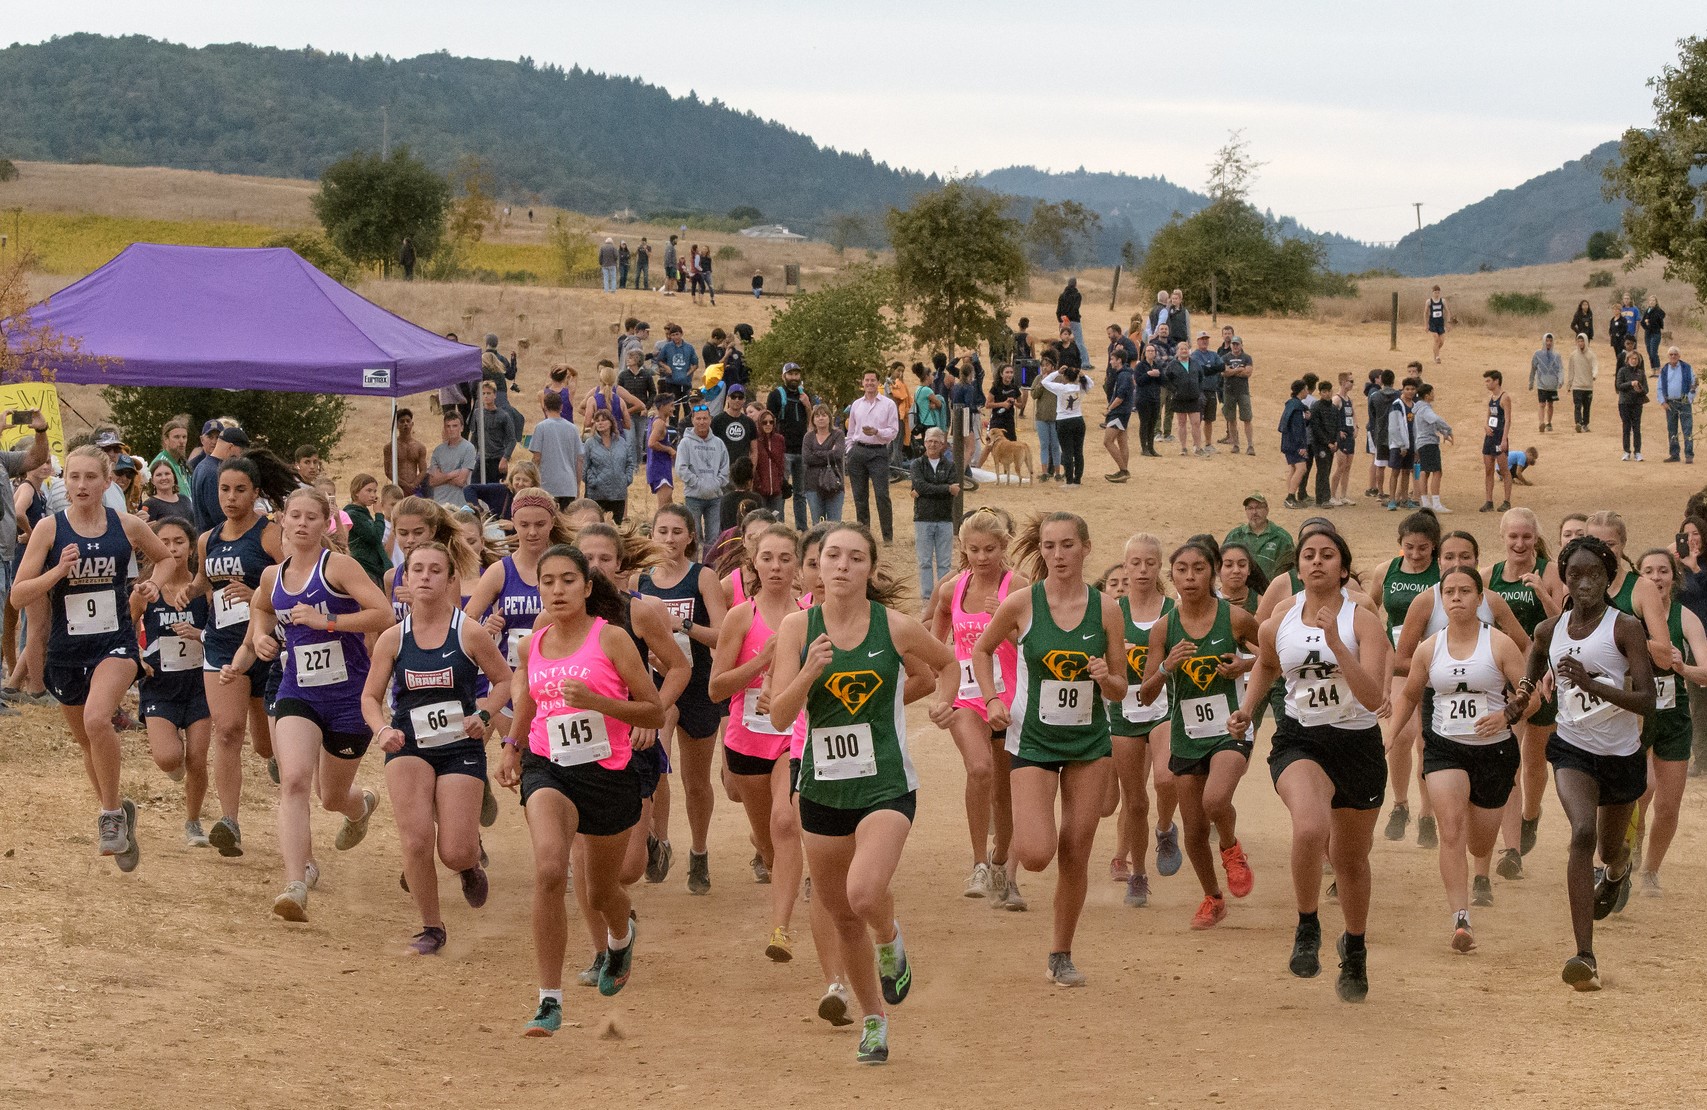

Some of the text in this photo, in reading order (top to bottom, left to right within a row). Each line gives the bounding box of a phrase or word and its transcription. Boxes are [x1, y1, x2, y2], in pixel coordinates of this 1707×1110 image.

[67, 557, 117, 578] NAPA
[205, 556, 246, 578] NAPA
[87, 599, 97, 618] 9
[504, 595, 544, 616] PETAL
[159, 611, 195, 627] NAPA
[178, 641, 187, 658] 2
[304, 648, 331, 671] 227
[407, 670, 451, 688] BRAVES
[1058, 687, 1079, 708] 98
[1307, 684, 1340, 708] 244
[1574, 692, 1606, 713] 24
[427, 709, 448, 731] 66
[1195, 702, 1215, 723] 96
[1450, 699, 1477, 720] 246
[557, 718, 593, 747] 145
[824, 733, 859, 760] 100
